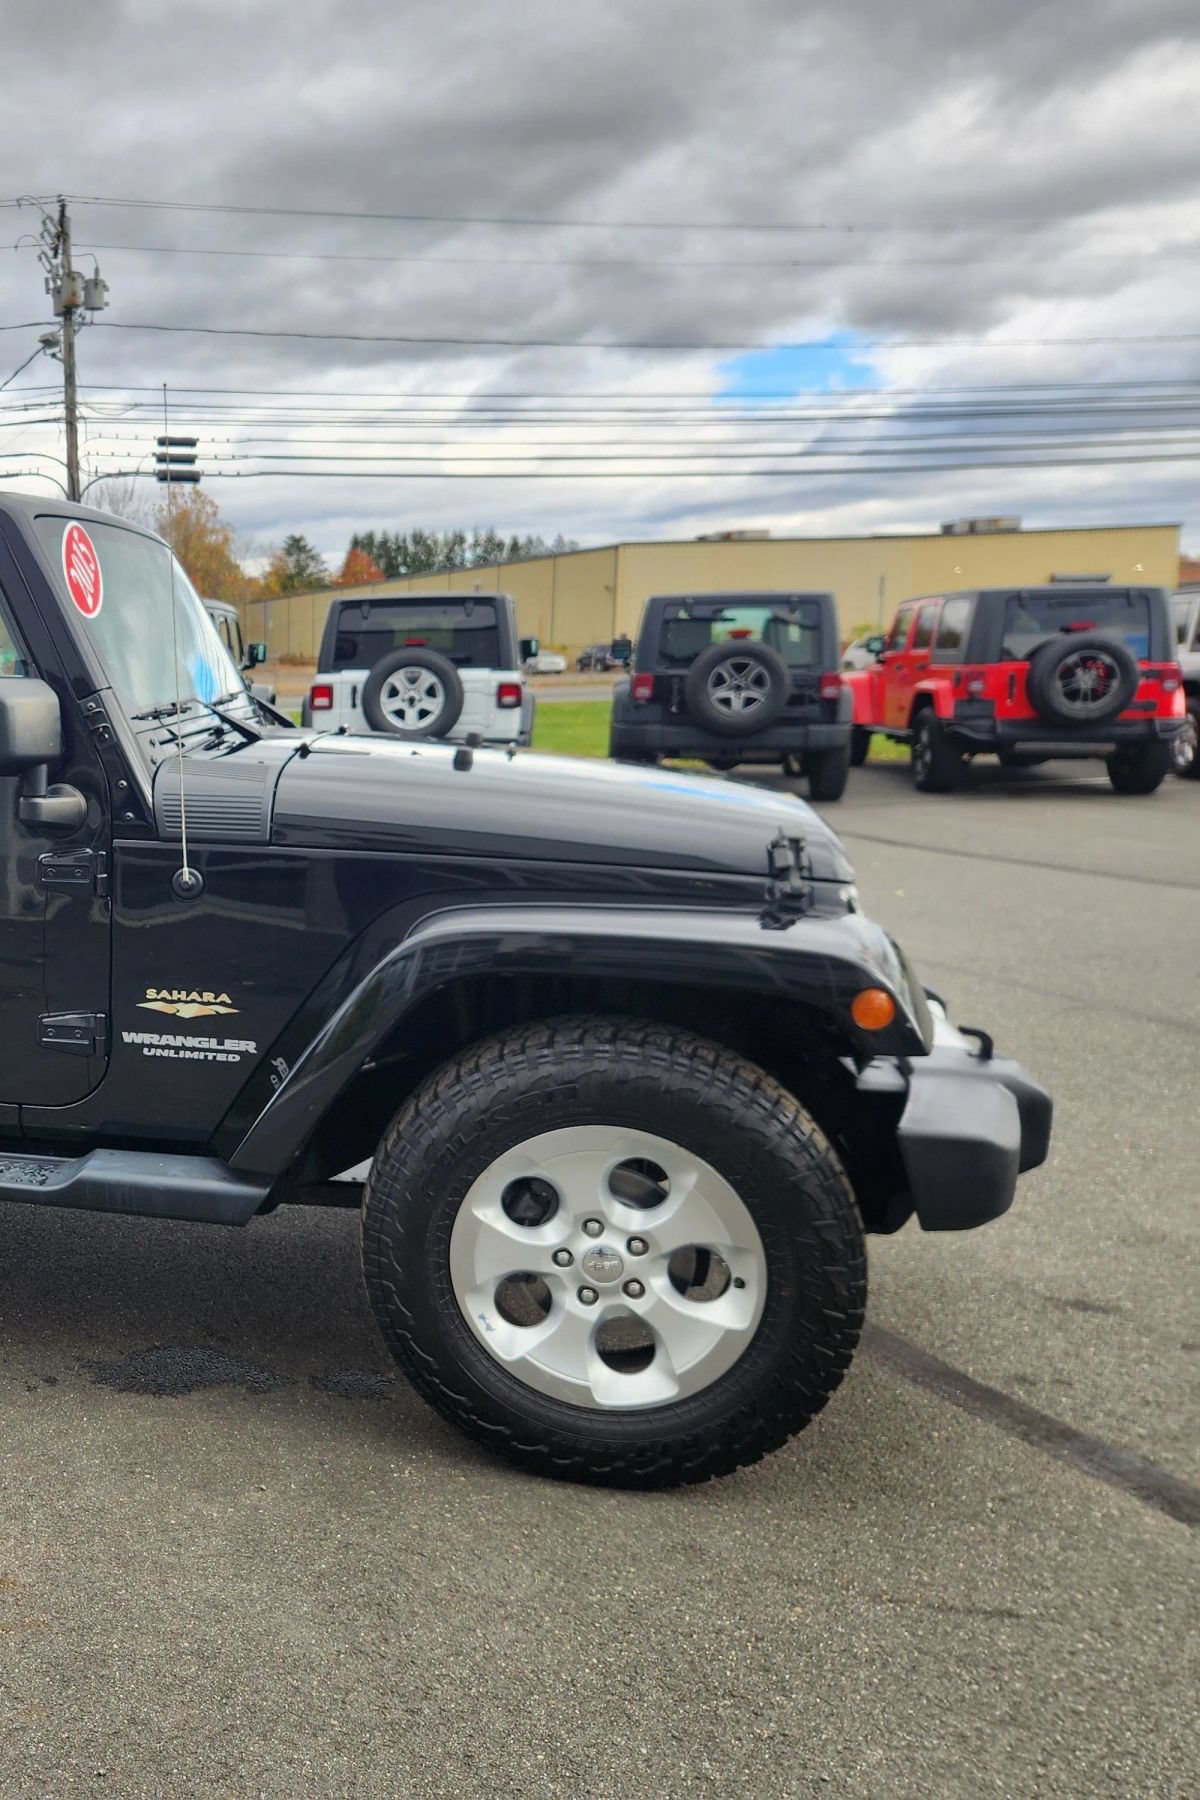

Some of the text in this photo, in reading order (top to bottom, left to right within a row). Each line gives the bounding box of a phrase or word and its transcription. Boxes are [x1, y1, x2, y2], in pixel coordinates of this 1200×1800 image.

[145, 988, 232, 1004] SAHARA
[121, 1031, 258, 1054] WRANGLER
[142, 1047, 241, 1062] UNLIMITED
